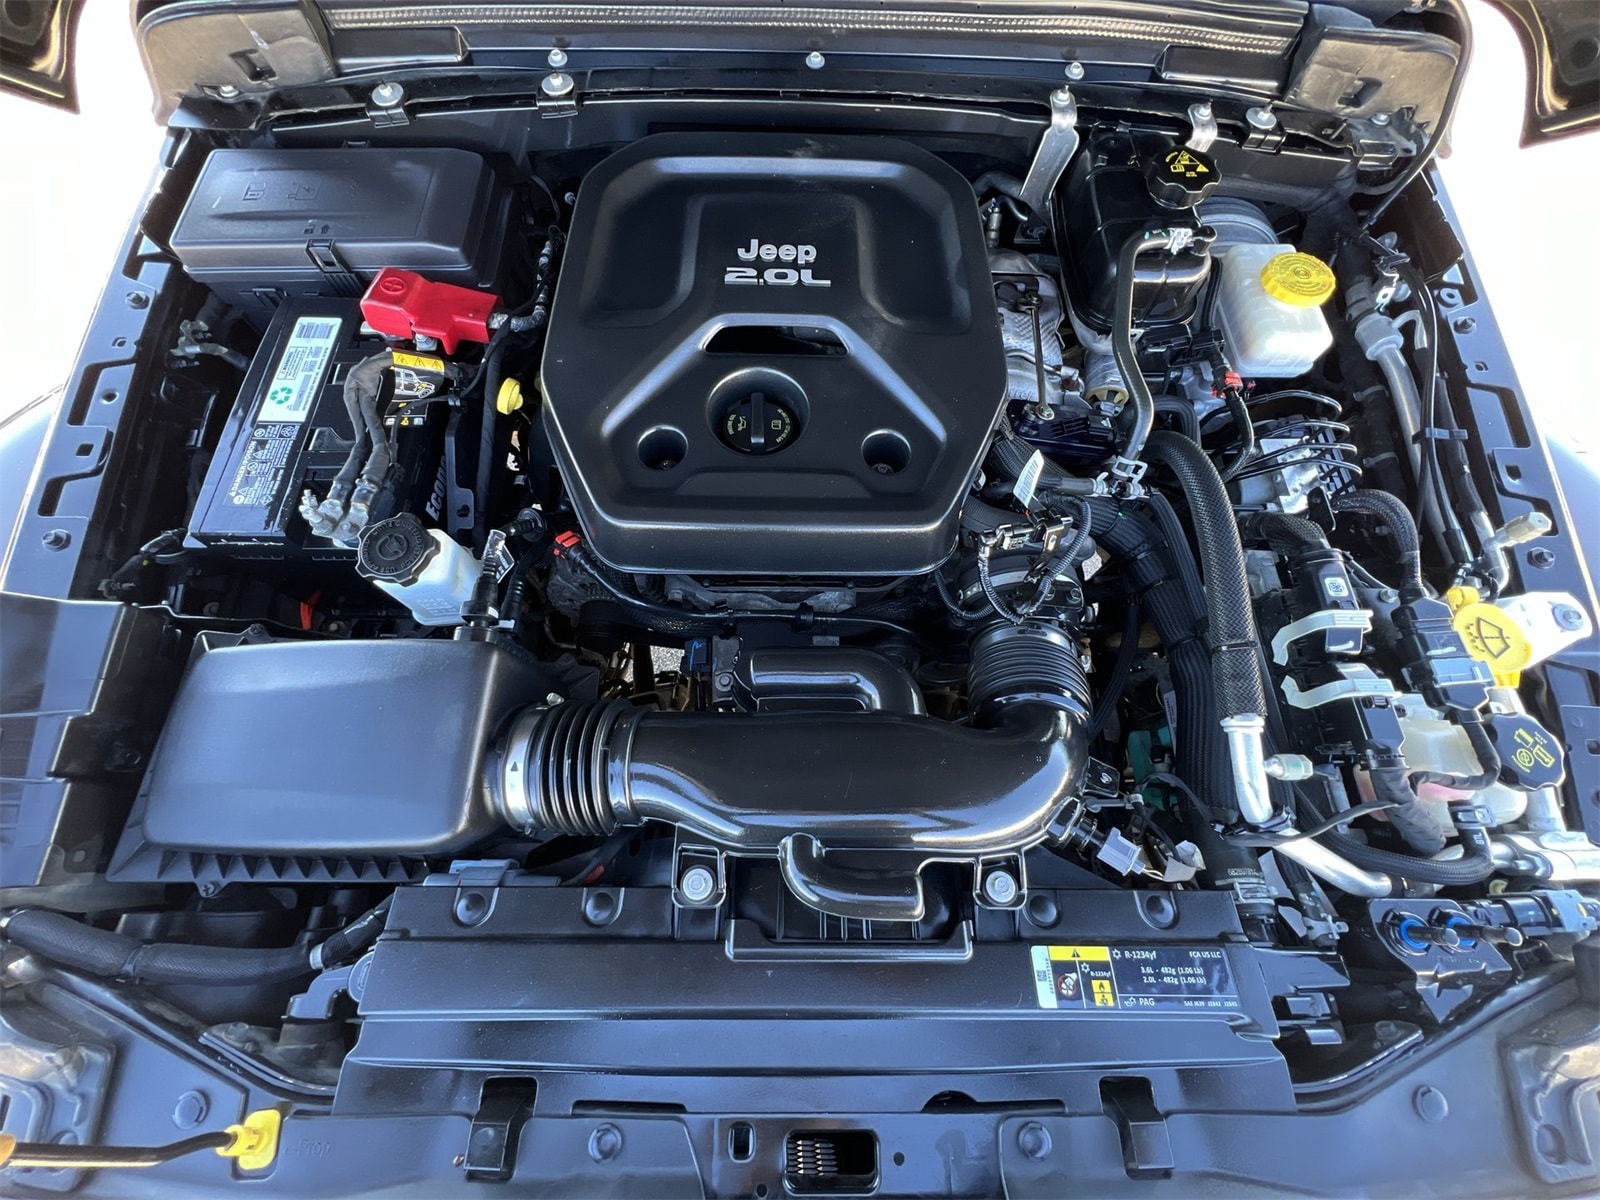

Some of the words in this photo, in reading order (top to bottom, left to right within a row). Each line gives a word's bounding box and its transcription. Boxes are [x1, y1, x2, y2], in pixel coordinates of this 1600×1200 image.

[737, 239, 817, 266] Jeep
[724, 267, 831, 287] 2.0L
[1124, 950, 1157, 960] R-1234yf
[1140, 966, 1154, 974] 3.6L
[1160, 966, 1176, 975] 482g
[1163, 976, 1179, 984] 482g
[1139, 998, 1155, 1006] PAG
